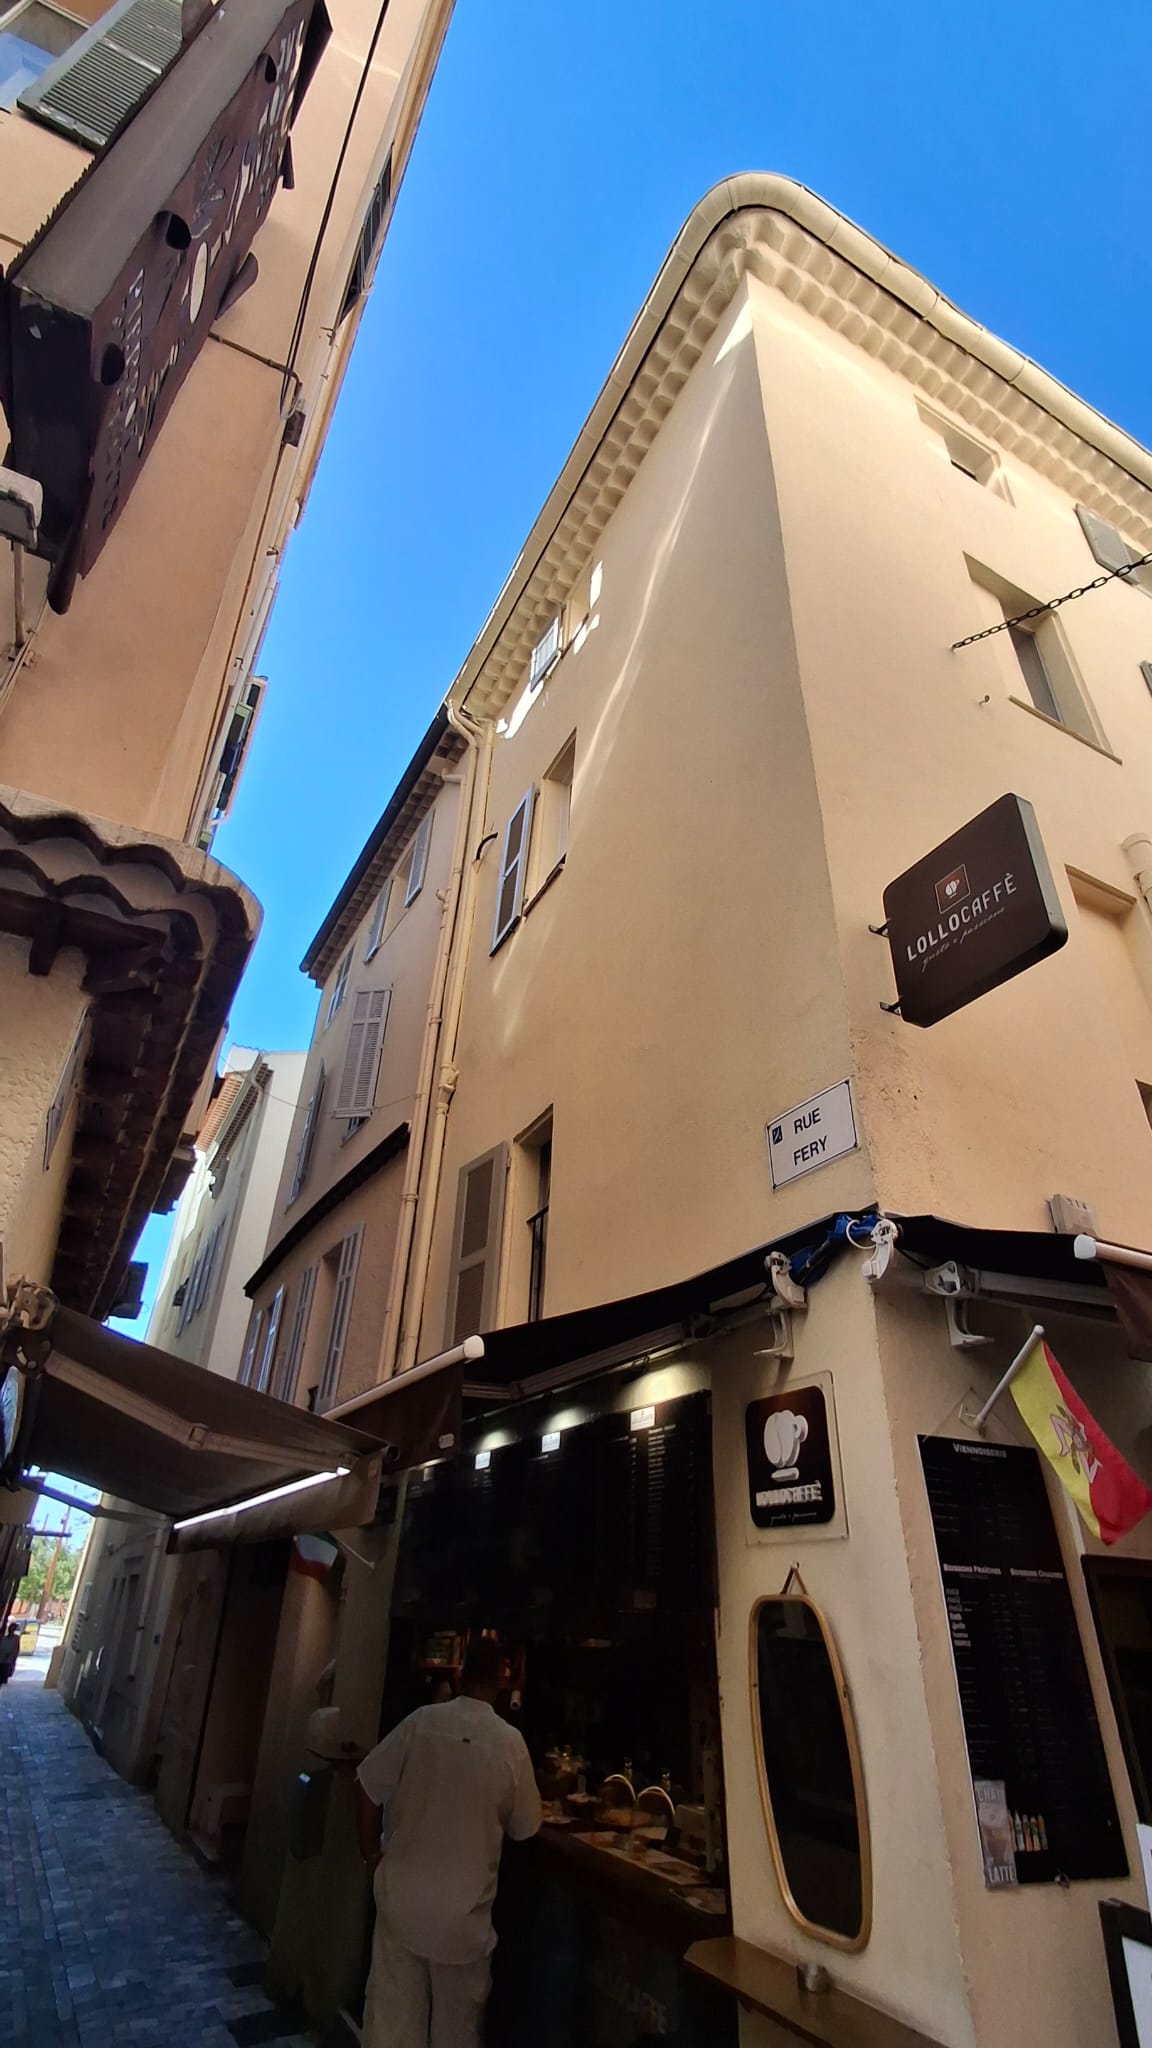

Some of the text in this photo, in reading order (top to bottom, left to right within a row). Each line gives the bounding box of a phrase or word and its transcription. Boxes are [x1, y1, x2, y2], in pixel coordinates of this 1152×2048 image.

[906, 872, 1017, 962] LOLLOCAFFÈ
[793, 1108, 822, 1134] RUE
[793, 1136, 828, 1166] FERY
